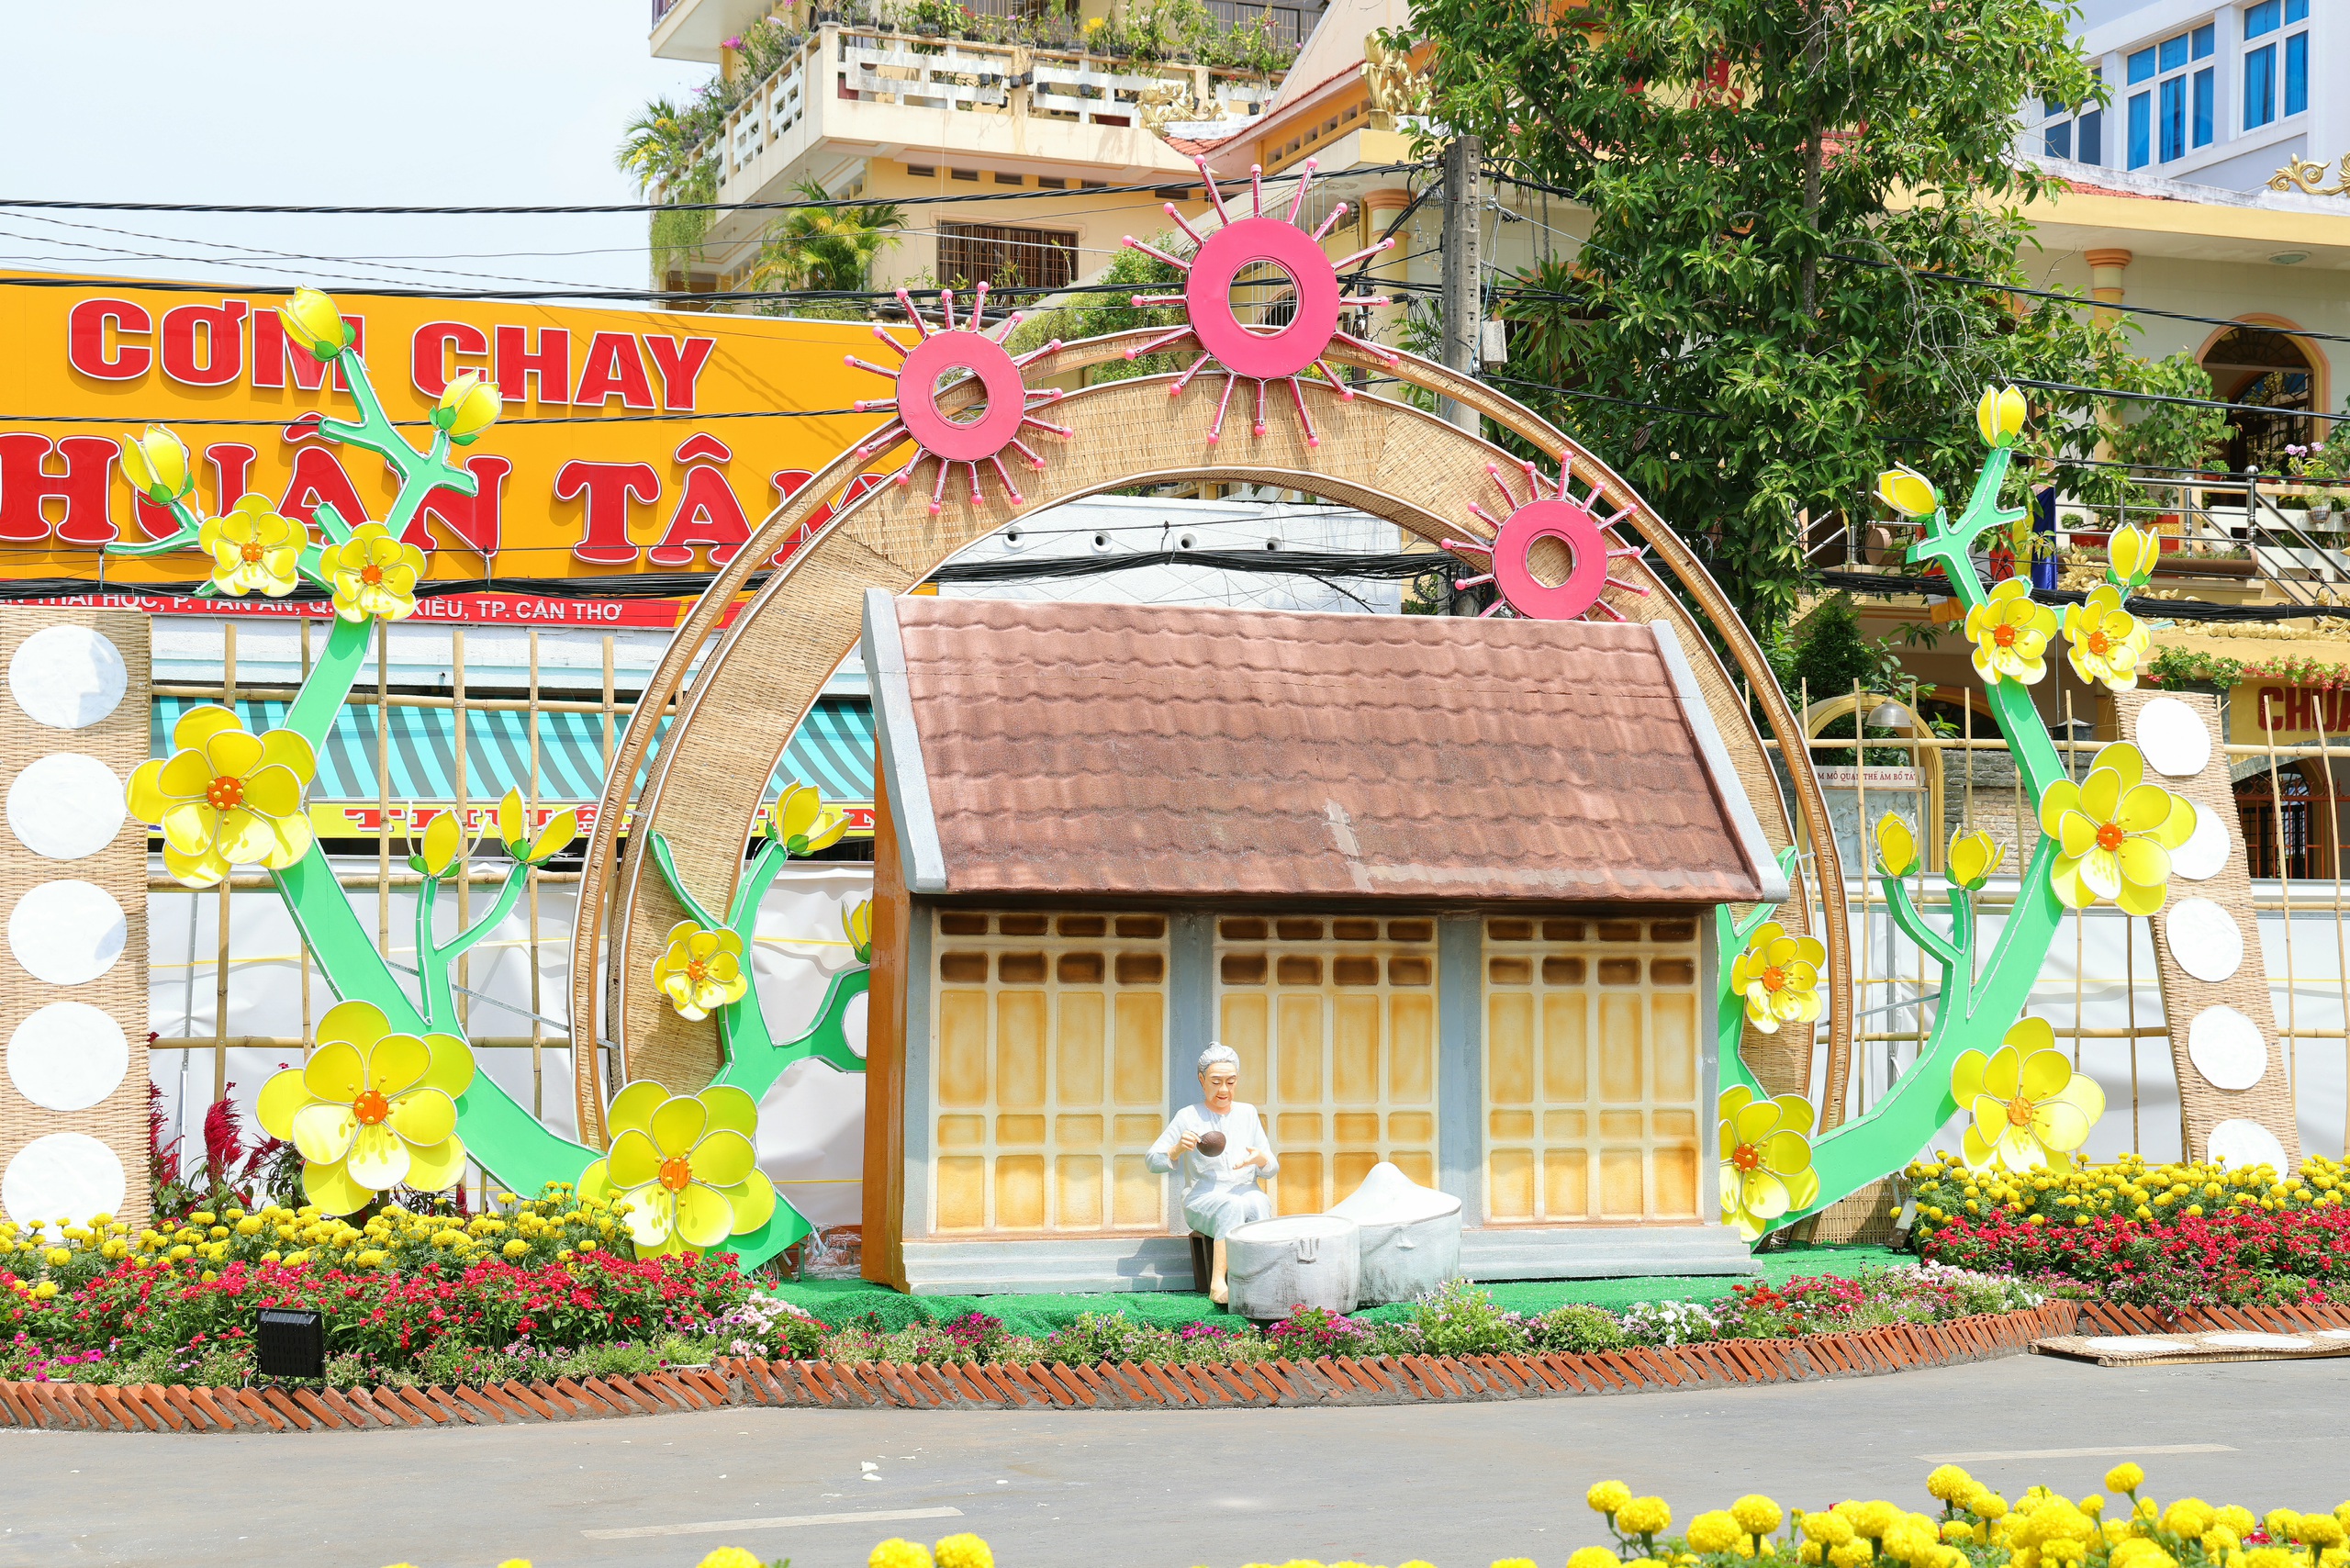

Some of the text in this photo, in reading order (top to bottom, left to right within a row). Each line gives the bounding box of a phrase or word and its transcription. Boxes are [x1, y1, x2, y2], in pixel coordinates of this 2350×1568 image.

[410, 320, 717, 411] CHAY
[476, 600, 510, 618] TP.
[572, 602, 623, 622] THƠ
[1840, 773, 1858, 782] QUA
[1905, 770, 1917, 780] TÁ
